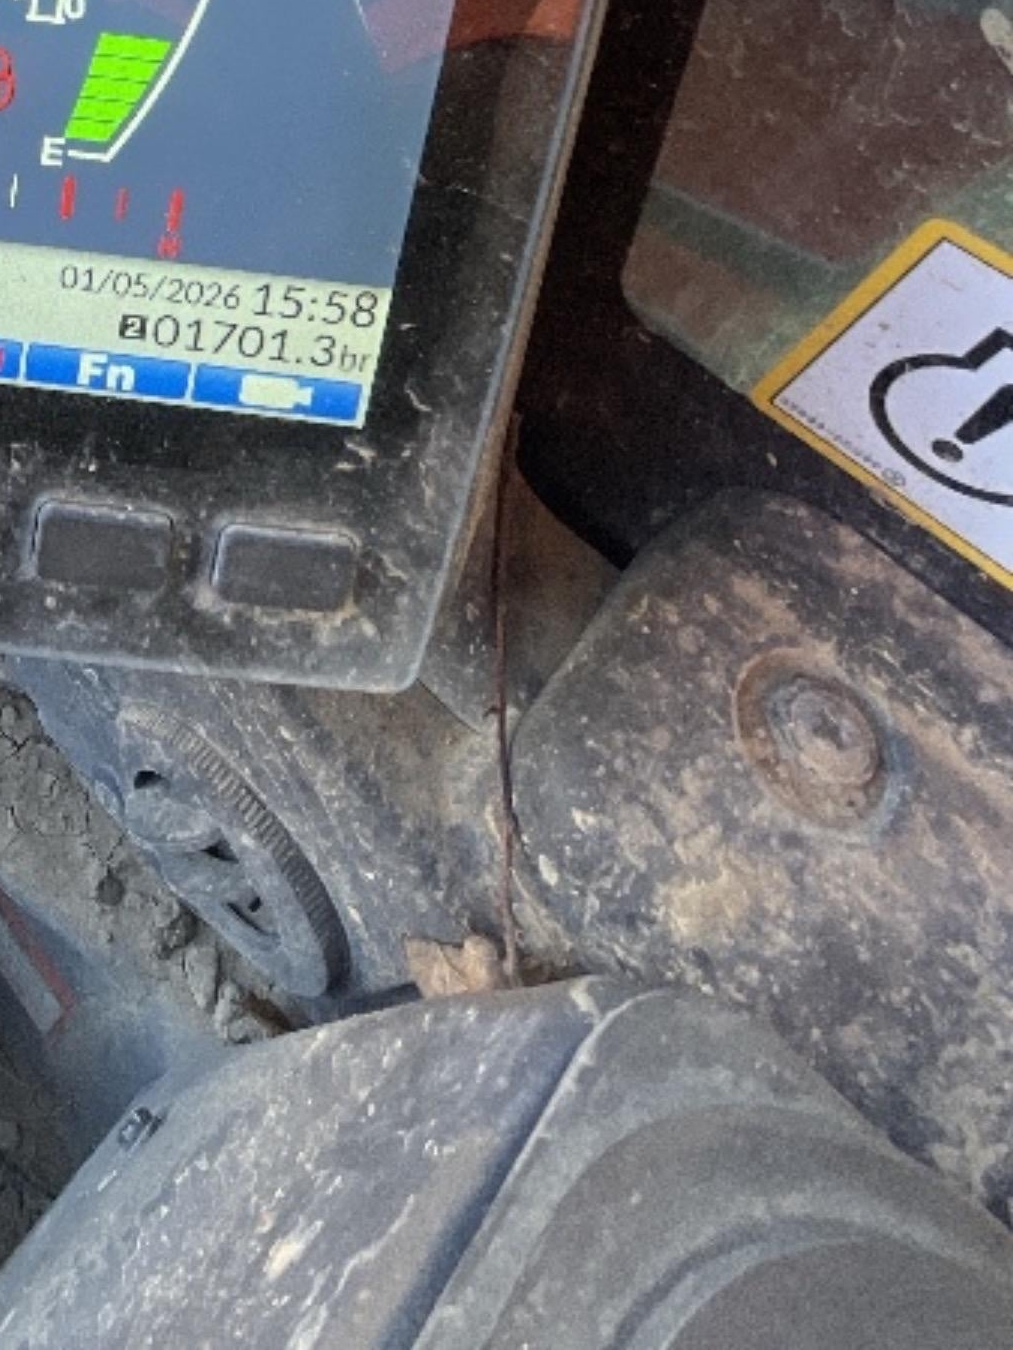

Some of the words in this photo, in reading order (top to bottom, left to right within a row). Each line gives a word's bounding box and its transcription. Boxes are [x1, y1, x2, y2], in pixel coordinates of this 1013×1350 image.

[40, 136, 67, 167] E
[59, 264, 241, 311] 01/05/2026
[252, 282, 379, 329] 15:58
[77, 352, 136, 392] Fn
